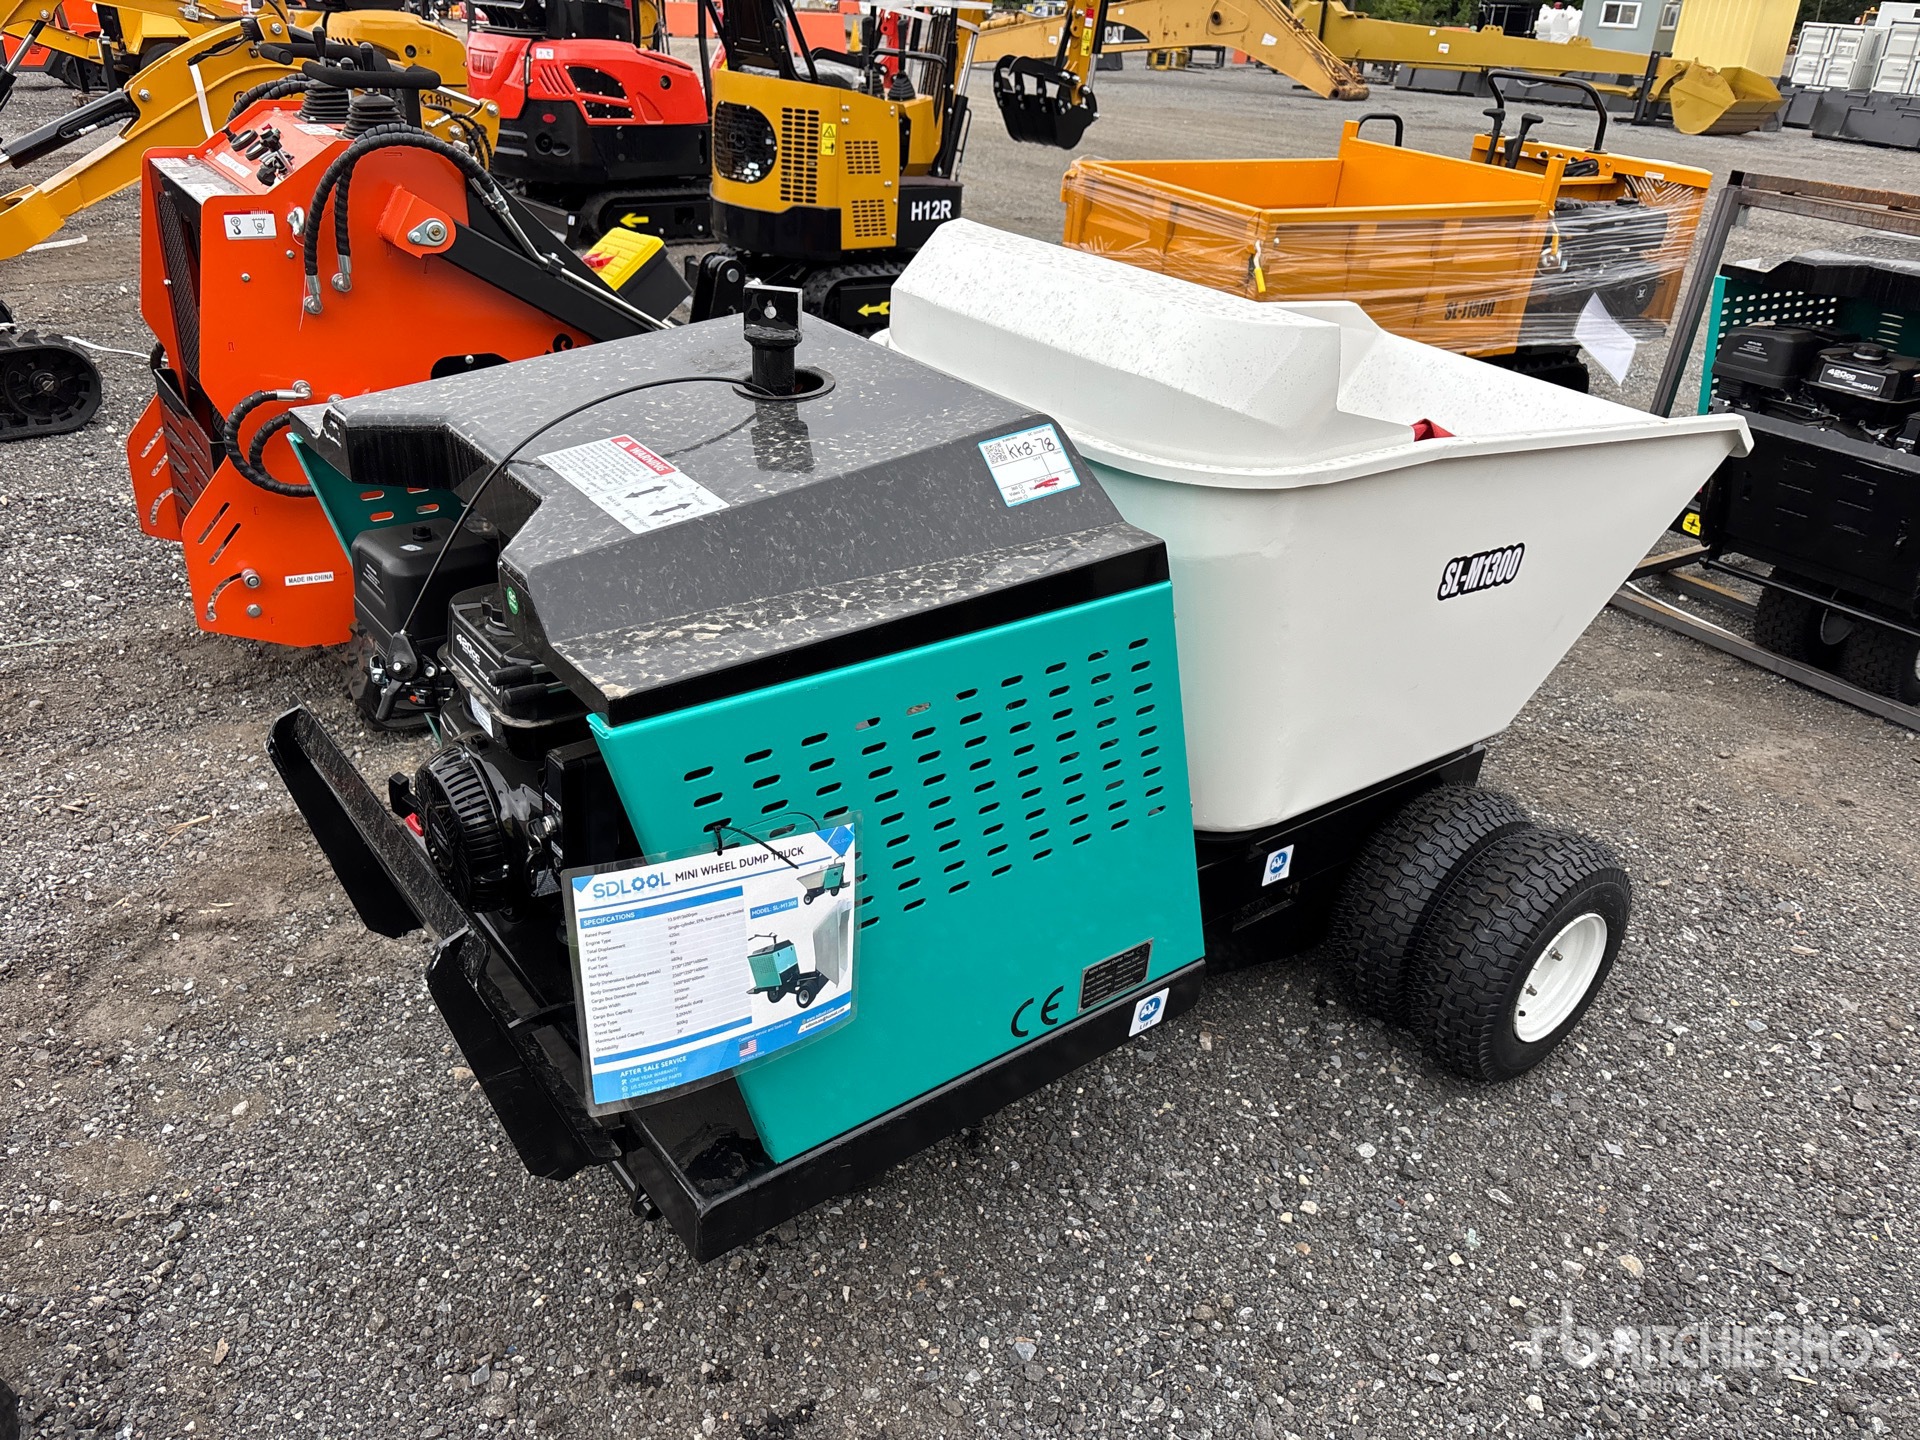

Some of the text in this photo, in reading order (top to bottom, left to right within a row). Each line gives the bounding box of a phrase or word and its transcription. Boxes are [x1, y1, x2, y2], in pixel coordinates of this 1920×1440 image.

[1104, 26, 1125, 42] CAT
[911, 200, 952, 221] H12R
[630, 448, 668, 472] WARNING
[1438, 544, 1524, 600] SL-M1300
[675, 868, 698, 882] MINI
[700, 861, 737, 876] WHEEL
[740, 854, 769, 868] DUMP
[771, 846, 804, 860] TRUCK
[584, 912, 636, 926] SPECIFCATIONS
[598, 944, 626, 952] Displacement
[602, 976, 625, 985] Dimensions
[602, 985, 626, 994] Dimensions
[1011, 986, 1064, 1038] CE
[620, 1056, 687, 1078] AFTER SALE SERVICE
